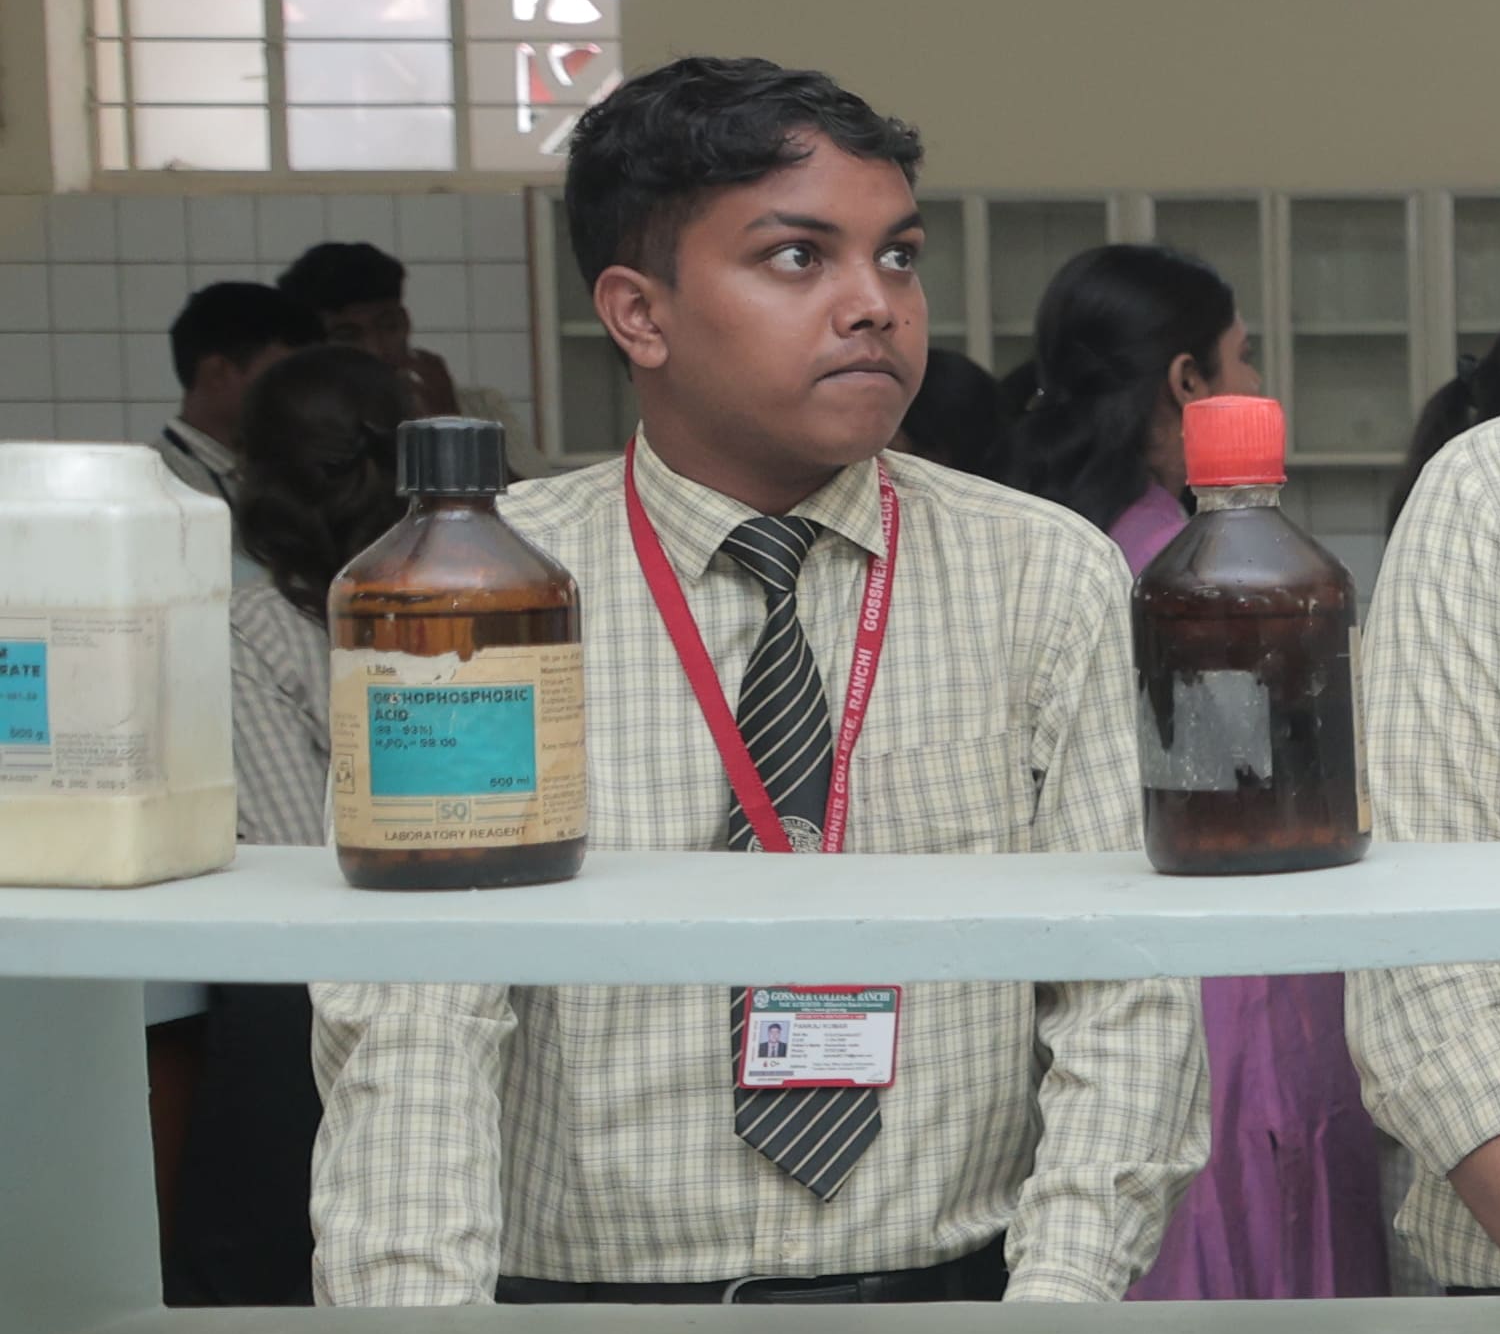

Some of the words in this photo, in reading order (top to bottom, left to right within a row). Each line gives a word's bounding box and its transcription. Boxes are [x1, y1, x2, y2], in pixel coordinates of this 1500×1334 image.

[863, 558, 888, 632] GOSSNER
[881, 490, 894, 555] OLLEGE,
[849, 648, 872, 710] RANCHI
[375, 709, 409, 722] ACID
[834, 716, 859, 794] COLLEGE,
[489, 777, 514, 788] 500
[384, 829, 466, 843] LABORATORY
[469, 825, 527, 840] REAGENT
[828, 799, 845, 852] SSNER
